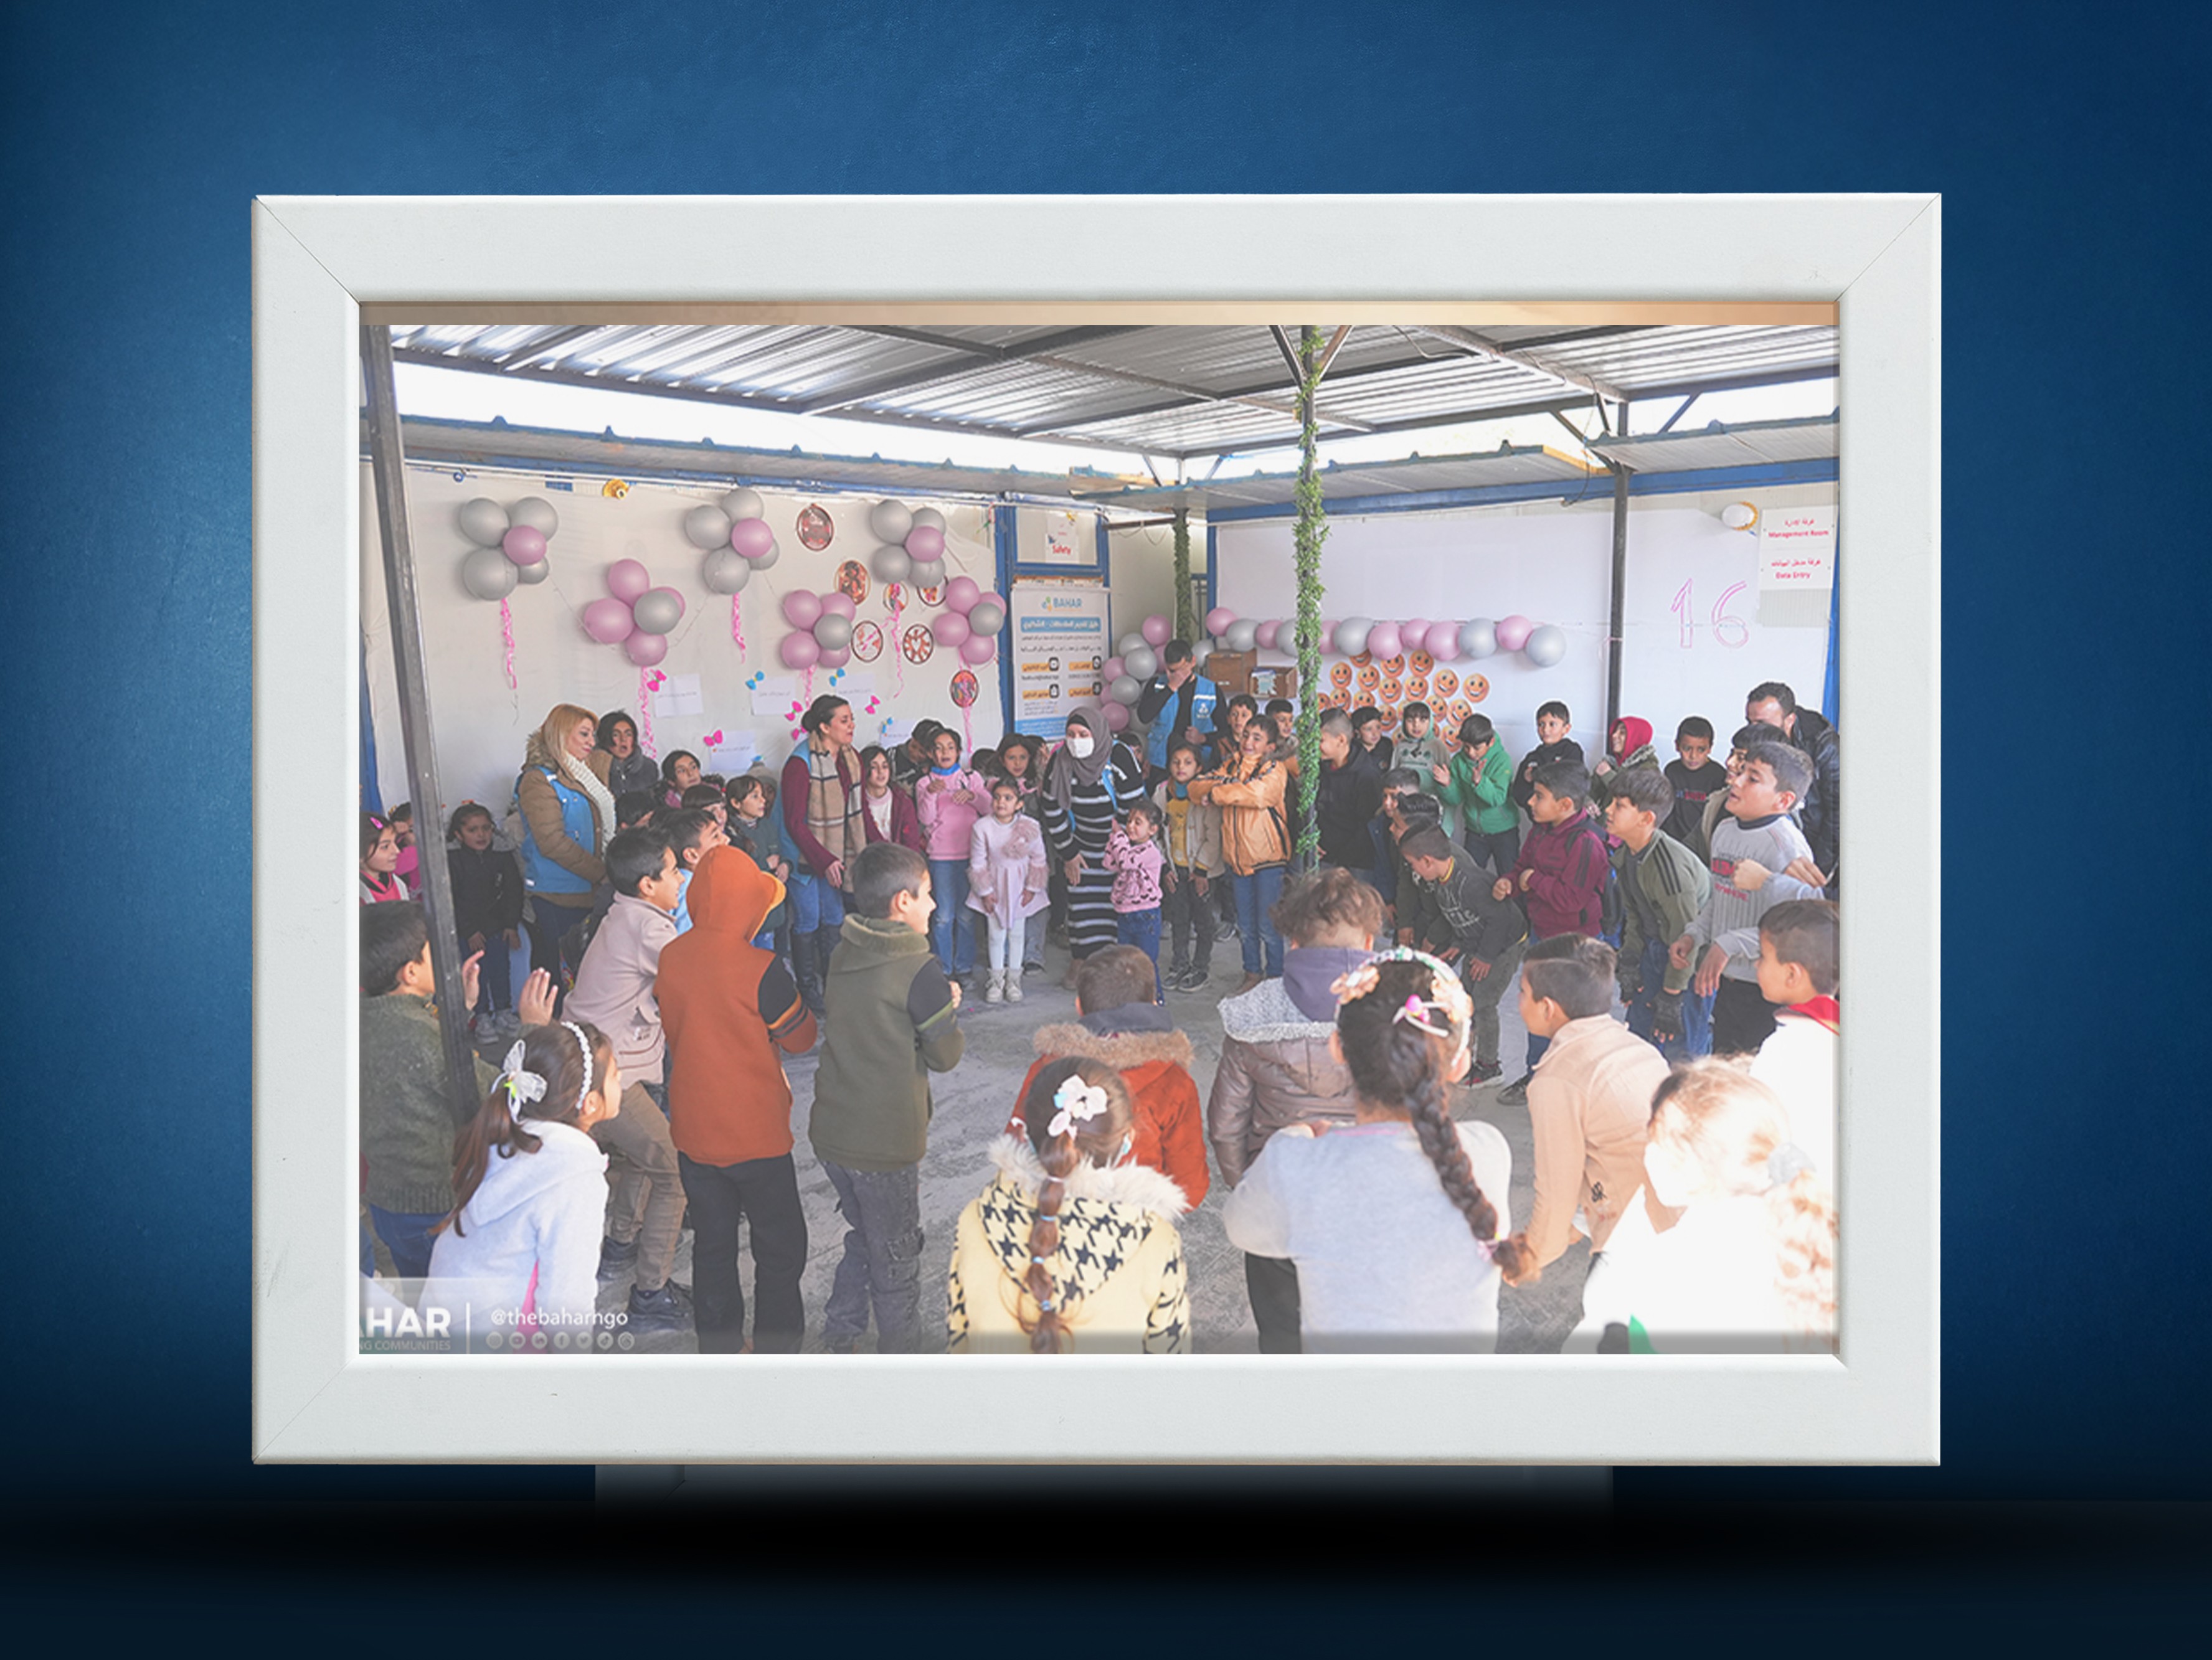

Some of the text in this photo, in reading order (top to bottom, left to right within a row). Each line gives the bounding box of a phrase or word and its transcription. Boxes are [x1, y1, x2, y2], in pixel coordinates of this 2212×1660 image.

[1052, 545, 1071, 555] Safety
[1053, 598, 1082, 608] BAHAR
[1670, 578, 1749, 649] 16
